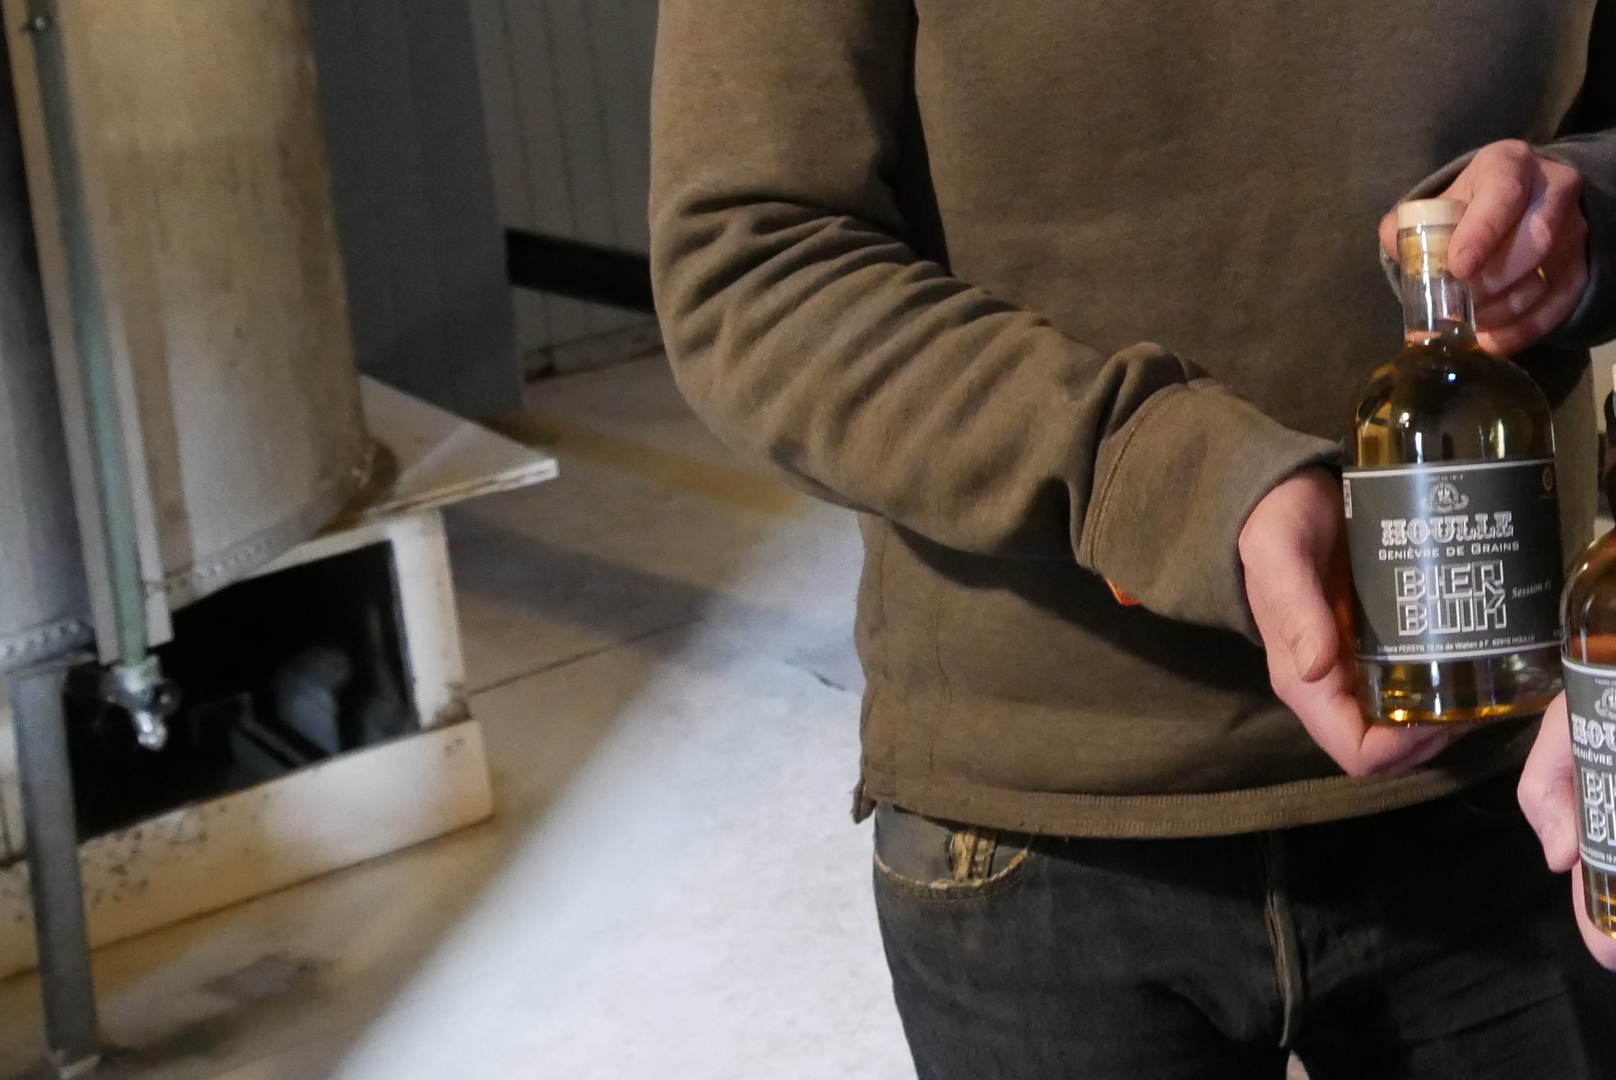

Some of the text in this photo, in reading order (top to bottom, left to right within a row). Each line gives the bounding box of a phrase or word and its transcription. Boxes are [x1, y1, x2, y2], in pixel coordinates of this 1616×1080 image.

[1381, 511, 1513, 546] HOULLE
[1446, 545, 1465, 557] DE
[1395, 559, 1506, 602] BIER
[1511, 582, 1543, 600] Session
